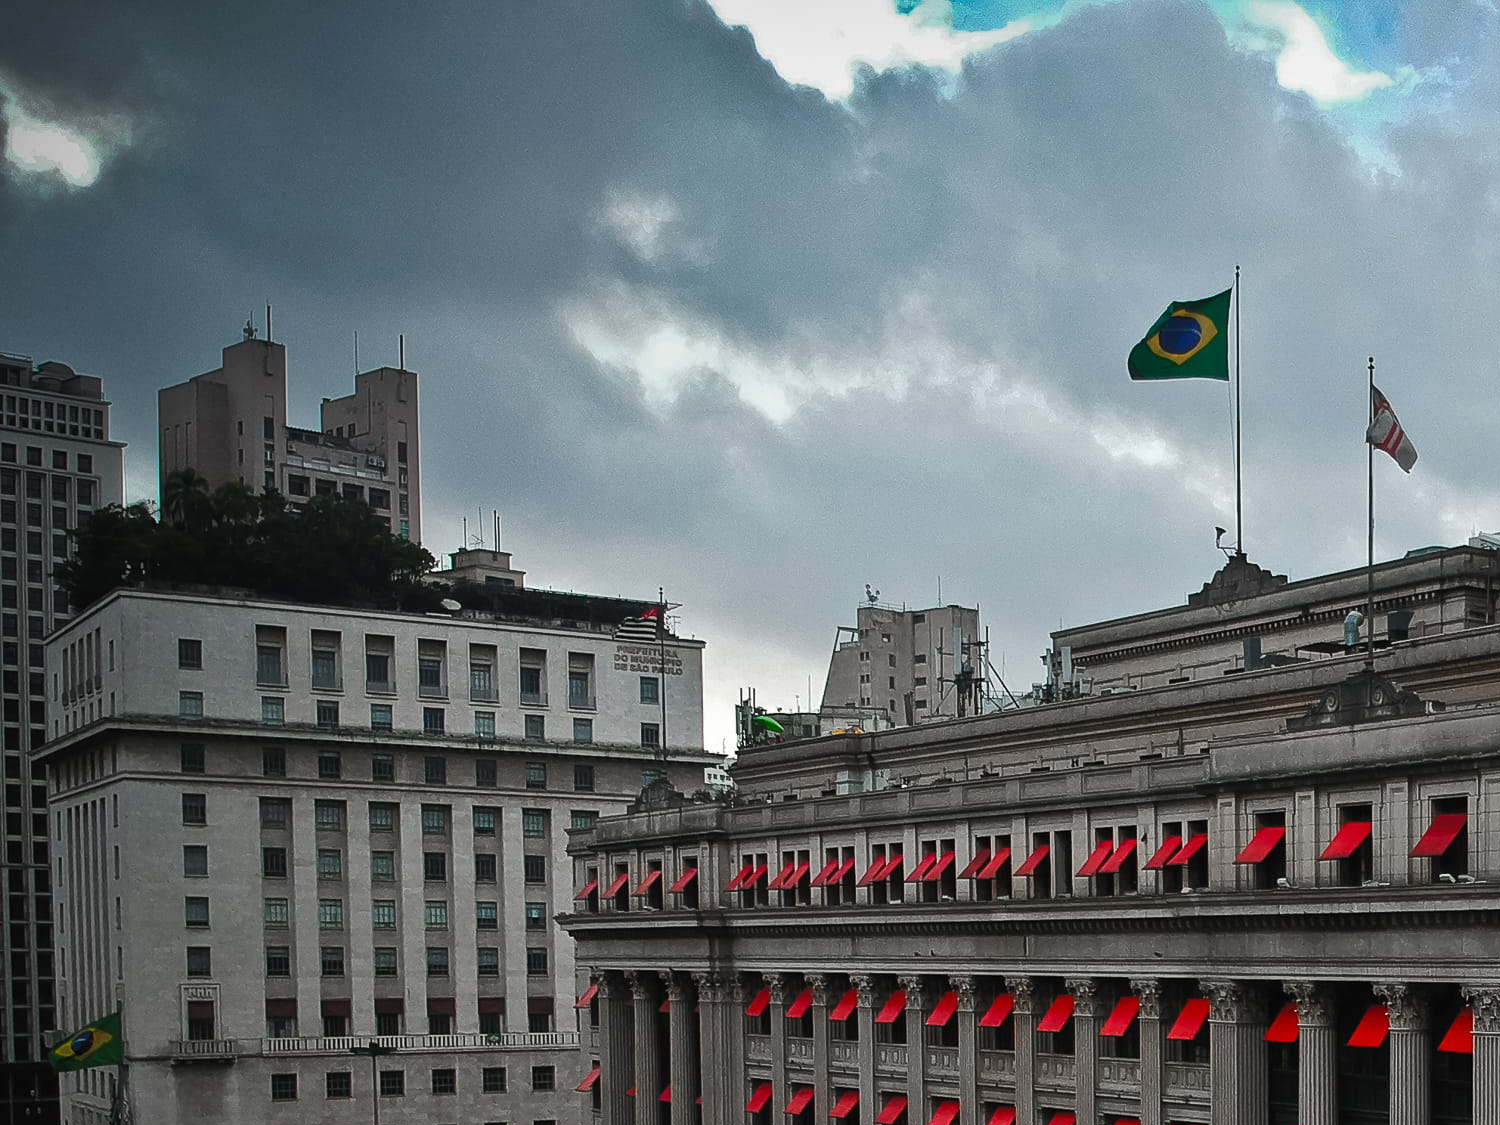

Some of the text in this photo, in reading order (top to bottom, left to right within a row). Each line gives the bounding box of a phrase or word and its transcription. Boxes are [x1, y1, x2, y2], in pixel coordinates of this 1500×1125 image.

[614, 654, 628, 662] DO
[617, 646, 678, 658] PREFEITURA
[614, 663, 628, 671] DE
[652, 666, 683, 675] PAULO
